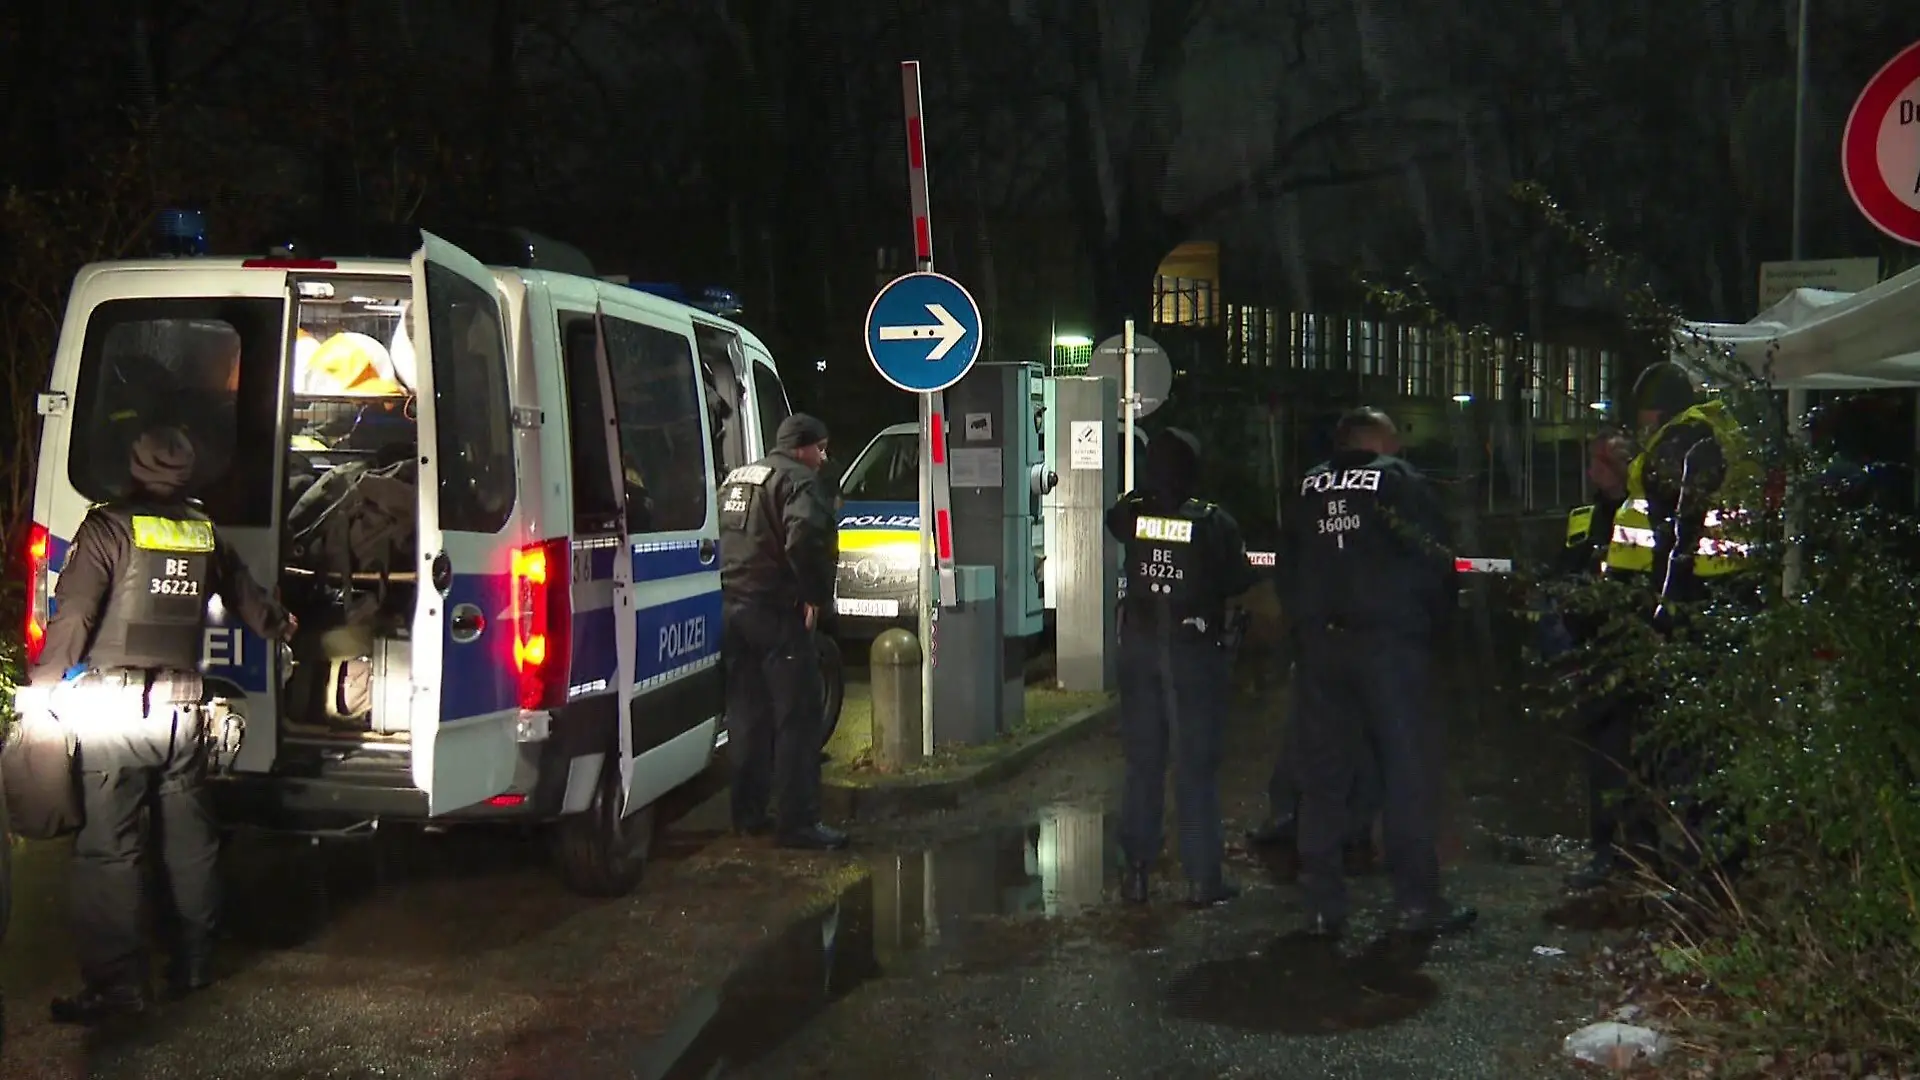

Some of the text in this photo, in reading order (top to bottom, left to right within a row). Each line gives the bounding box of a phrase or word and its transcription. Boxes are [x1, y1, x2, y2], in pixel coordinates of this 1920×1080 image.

[1301, 469, 1381, 496] POLIZEI
[1328, 500, 1347, 516] BE
[838, 515, 920, 528] POLIZE
[1136, 516, 1193, 542] POLIZEI
[1317, 514, 1360, 534] 36000
[1152, 548, 1172, 563] BE
[166, 558, 188, 576] BE
[1140, 562, 1184, 580] 3622a
[150, 578, 198, 595] 36221
[202, 628, 243, 666] EI
[659, 614, 706, 663] POLIZEI
